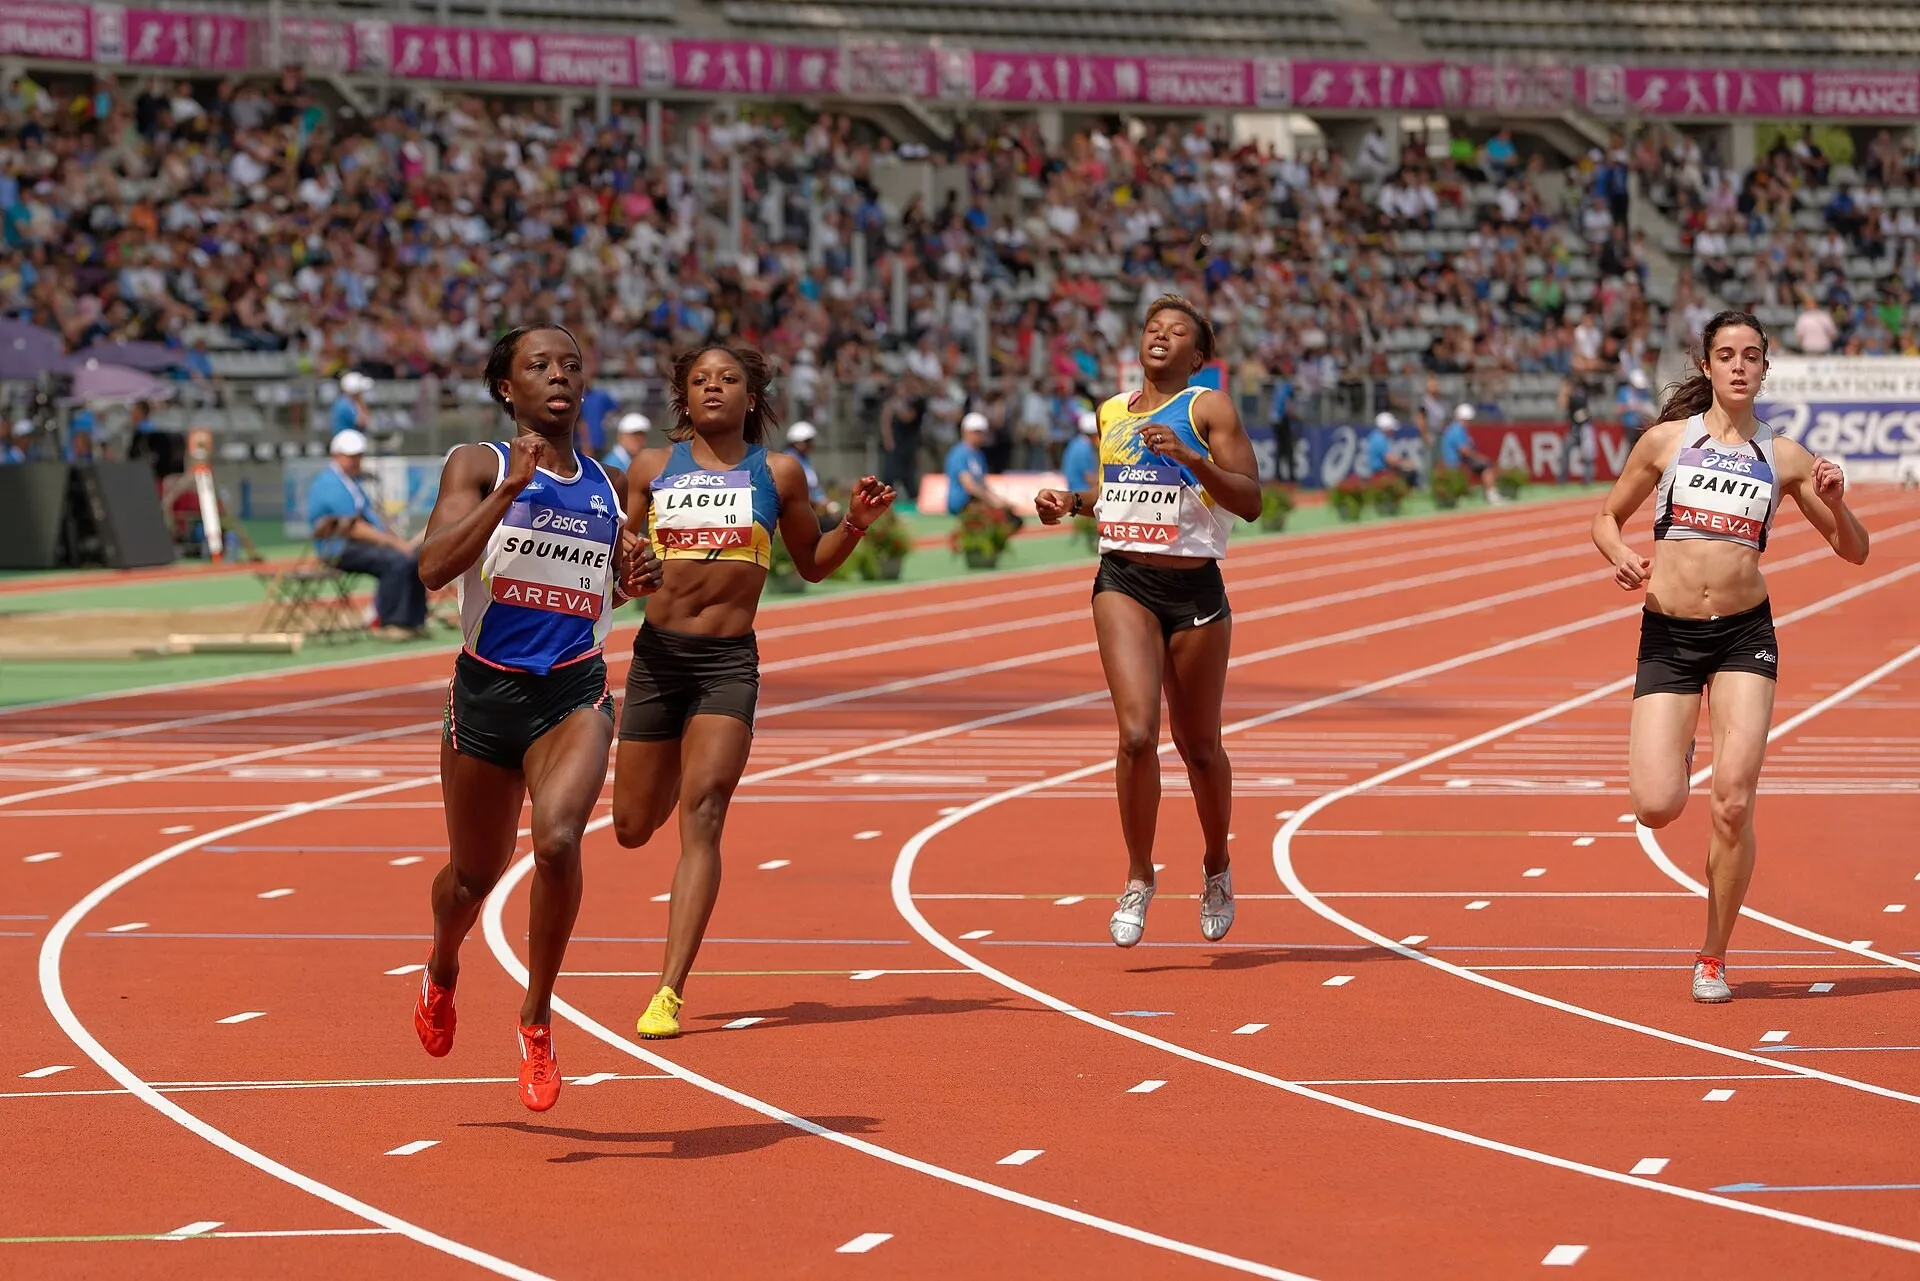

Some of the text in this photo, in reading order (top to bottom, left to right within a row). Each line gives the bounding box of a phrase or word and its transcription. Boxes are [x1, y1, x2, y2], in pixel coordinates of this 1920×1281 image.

[1827, 87, 1919, 114] FRANCE
[1688, 474, 1759, 500] BANTI
[666, 493, 737, 510] LAGUI
[1105, 489, 1178, 504] CALYDON
[1155, 512, 1162, 521] 3
[1744, 506, 1750, 516] 1
[724, 514, 737, 525] 10
[1680, 509, 1752, 535] AREVA
[665, 531, 743, 545] AREVA
[1103, 524, 1169, 540] AREVA
[503, 537, 607, 569] SOUMARE
[579, 576, 591, 590] 13
[503, 584, 592, 614] AREVA
